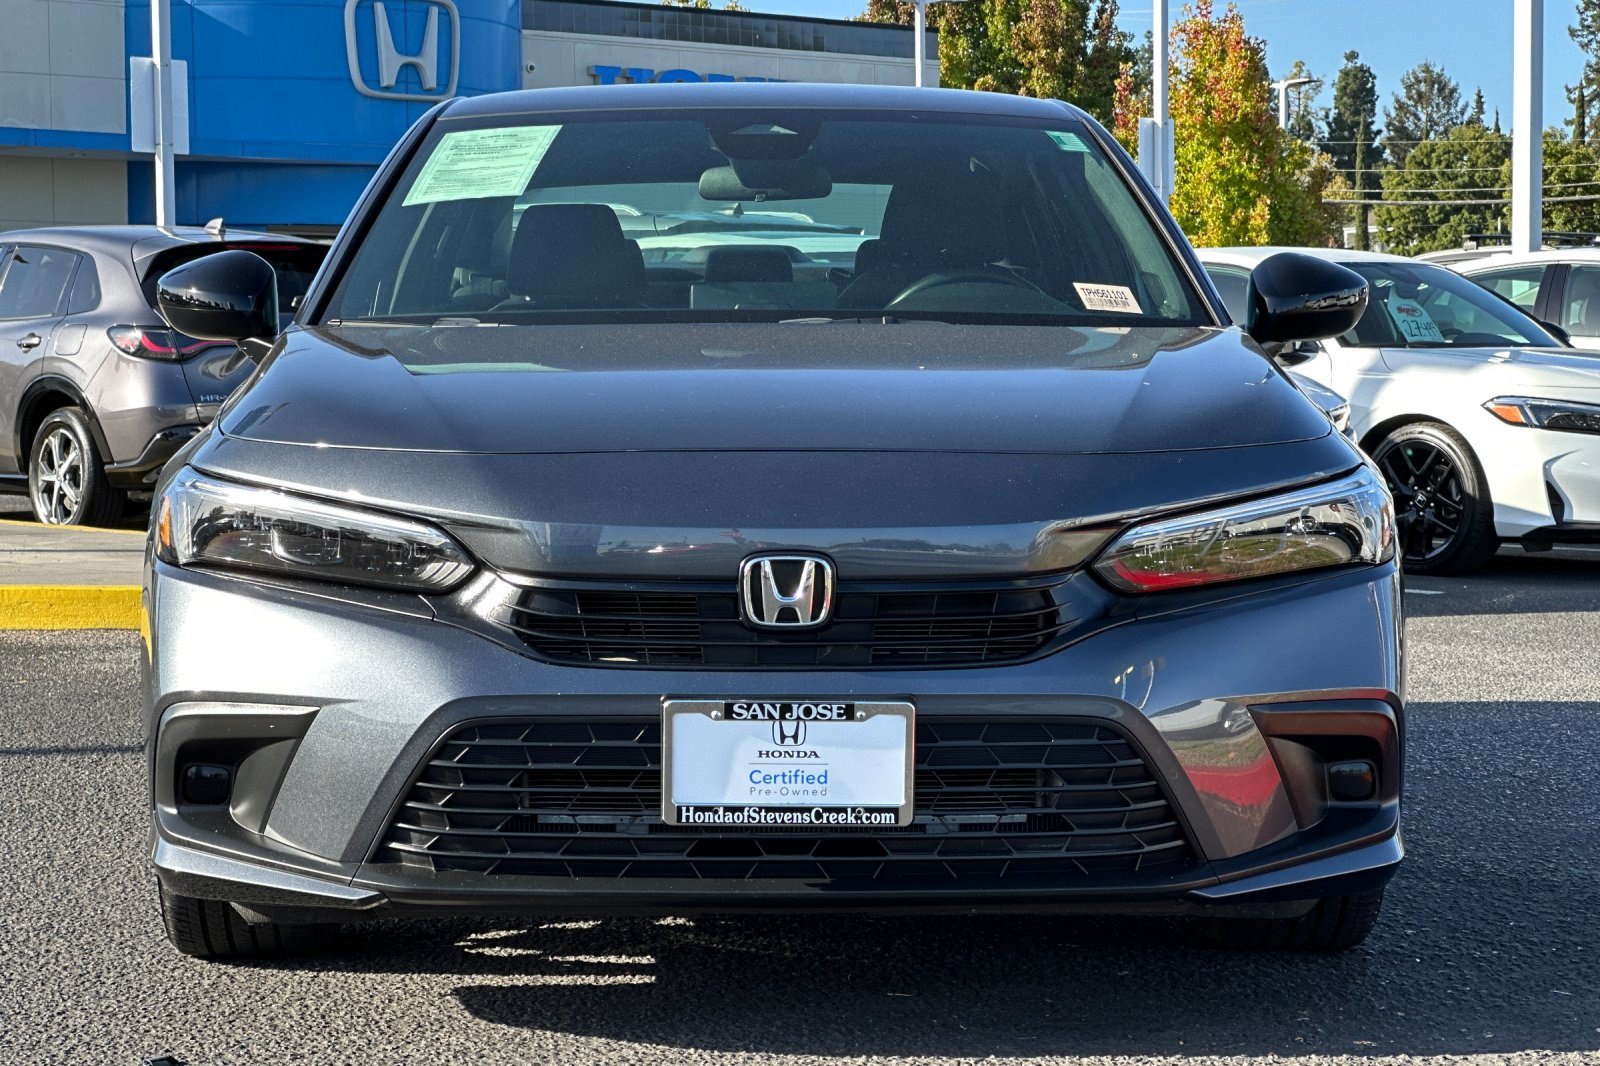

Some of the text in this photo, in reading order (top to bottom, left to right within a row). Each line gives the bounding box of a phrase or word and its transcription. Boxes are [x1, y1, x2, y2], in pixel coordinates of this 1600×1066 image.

[732, 703, 847, 720] SAN JOSE
[757, 750, 821, 759] HONDA
[749, 769, 828, 785] Certified
[749, 787, 828, 797] Pre-Owned
[680, 806, 896, 825] HondaofStevensCreek.com
